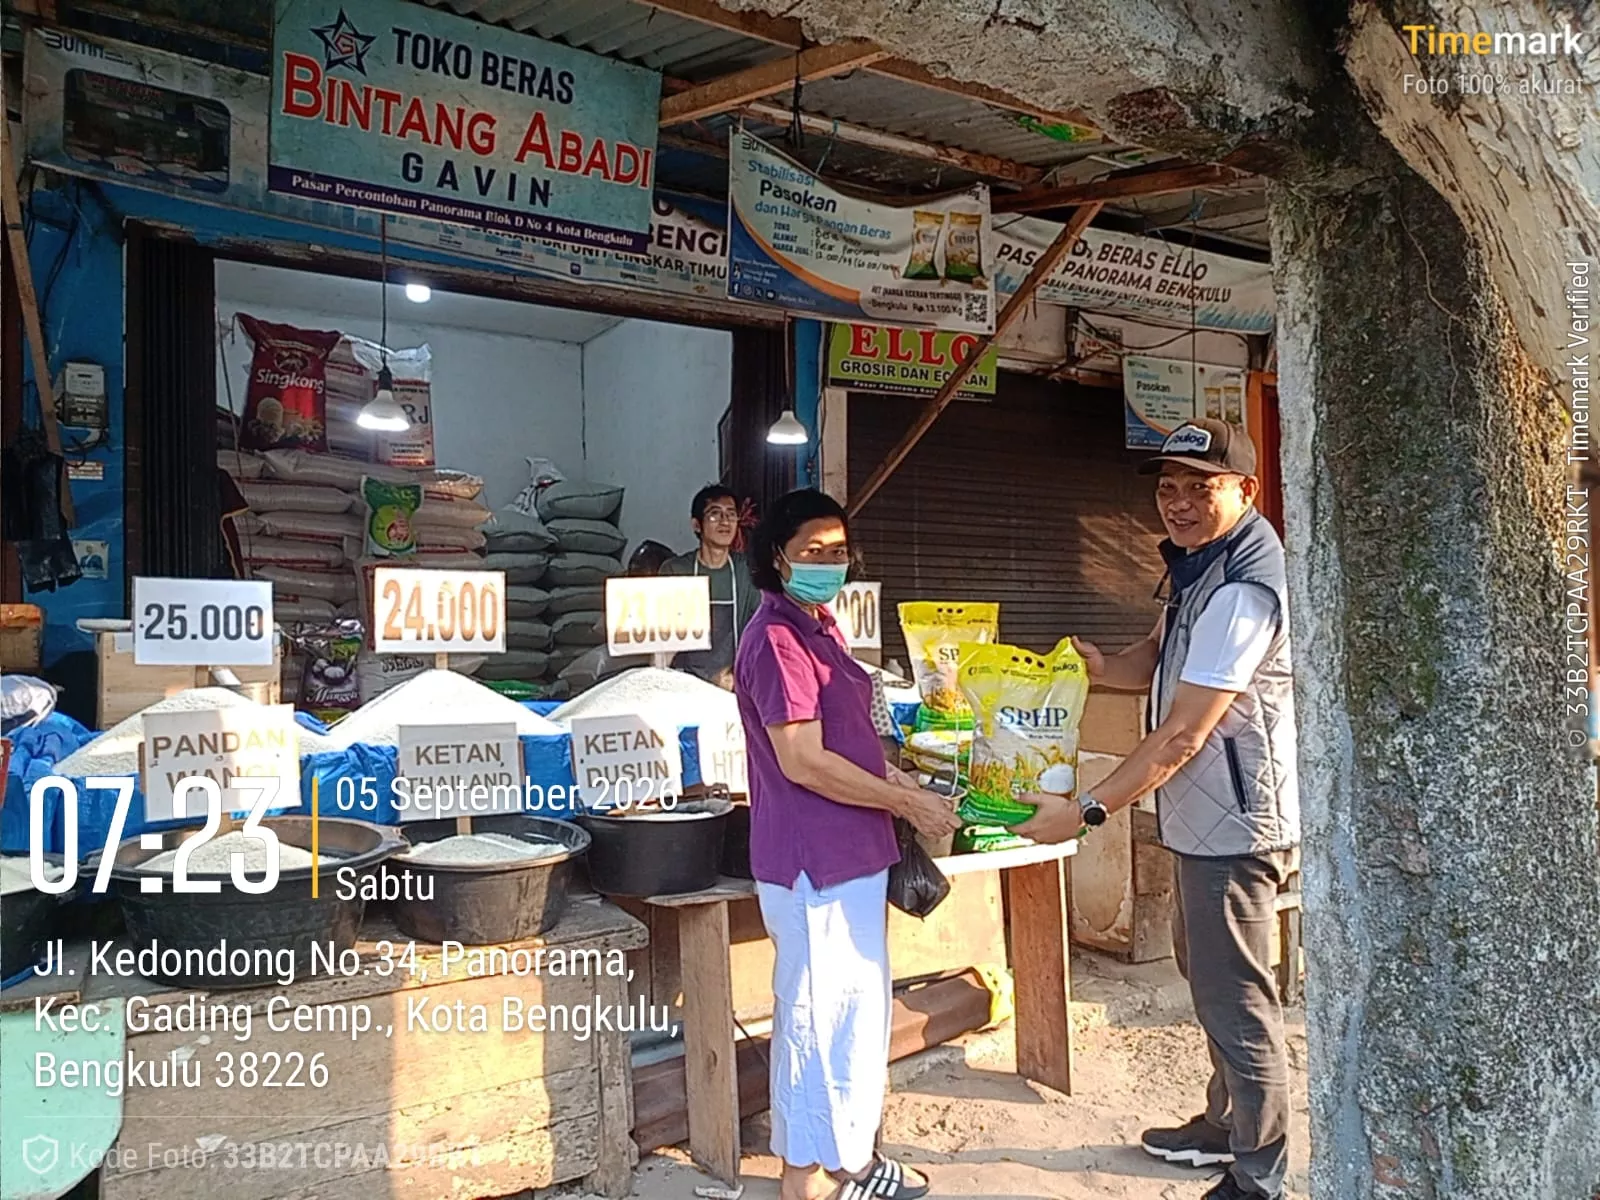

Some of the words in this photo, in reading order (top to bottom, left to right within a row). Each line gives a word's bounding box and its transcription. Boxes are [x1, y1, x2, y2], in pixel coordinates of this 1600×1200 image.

[391, 27, 473, 81] TOKO
[481, 50, 575, 105] BERAS
[282, 51, 498, 157] BINTANG
[513, 110, 654, 190] ABADI
[402, 151, 552, 209] GAVIN
[748, 160, 816, 188] Stabilisasi
[291, 174, 332, 193] Pasar
[335, 183, 417, 210] Percontohan
[420, 198, 482, 220] Panorama
[485, 212, 512, 227] Blok
[514, 216, 525, 229] D
[526, 218, 542, 232] No
[544, 221, 553, 234] 4
[555, 224, 582, 239] Kota
[584, 229, 634, 248] Bengkulu
[760, 180, 837, 213] Pasokan
[755, 201, 778, 216] dan
[859, 223, 893, 241] Beras
[1097, 242, 1158, 271] BERAS
[1159, 255, 1208, 282] ELLO
[1061, 259, 1152, 292] PANORAMA
[1155, 278, 1231, 304] BENGKULU
[850, 323, 979, 367] ELLO
[256, 369, 325, 394] Singkong
[841, 361, 896, 376] GROSIR
[901, 367, 929, 380] DAN
[1136, 381, 1171, 392] Pasokan
[144, 603, 264, 641] 25.000
[382, 579, 498, 641] 24.000
[1000, 706, 1068, 728] SPHP
[152, 728, 287, 759] PANDAN
[416, 743, 501, 766] KETAN
[585, 729, 665, 755] KETAN
[586, 760, 669, 788] DUSUN
